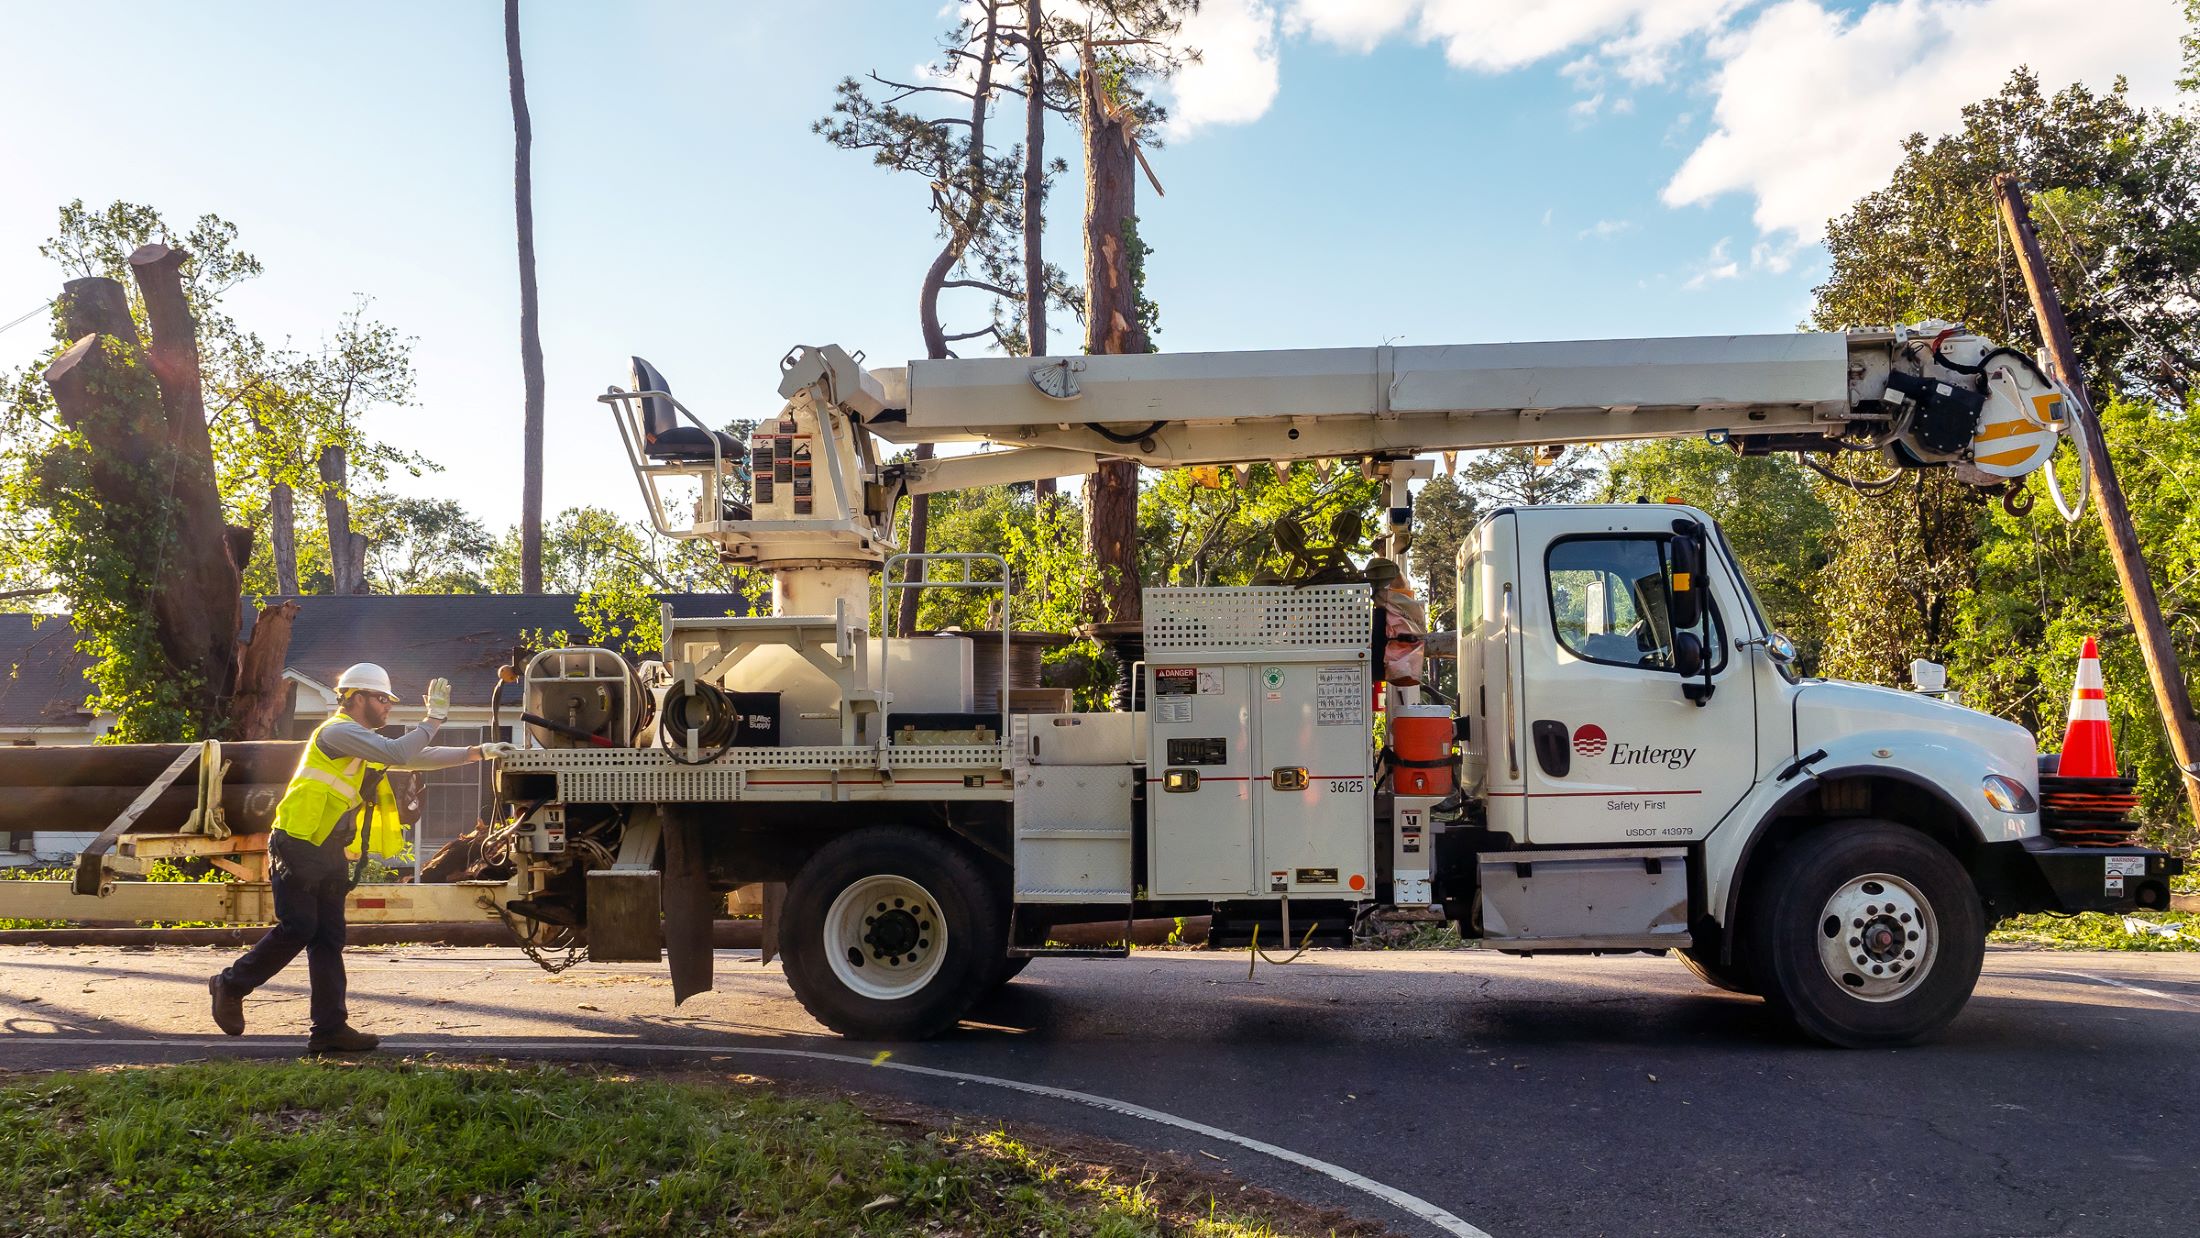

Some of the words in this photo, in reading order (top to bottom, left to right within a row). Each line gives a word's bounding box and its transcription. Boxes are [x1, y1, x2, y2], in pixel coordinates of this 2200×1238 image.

[1165, 669, 1194, 677] DANGER
[1609, 743, 1697, 770] Entergy
[1330, 781, 1363, 793] 36125
[1607, 800, 1640, 811] Safety
[1644, 800, 1666, 810] First
[1625, 828, 1657, 837] USDOT
[1661, 827, 1694, 836] 413979
